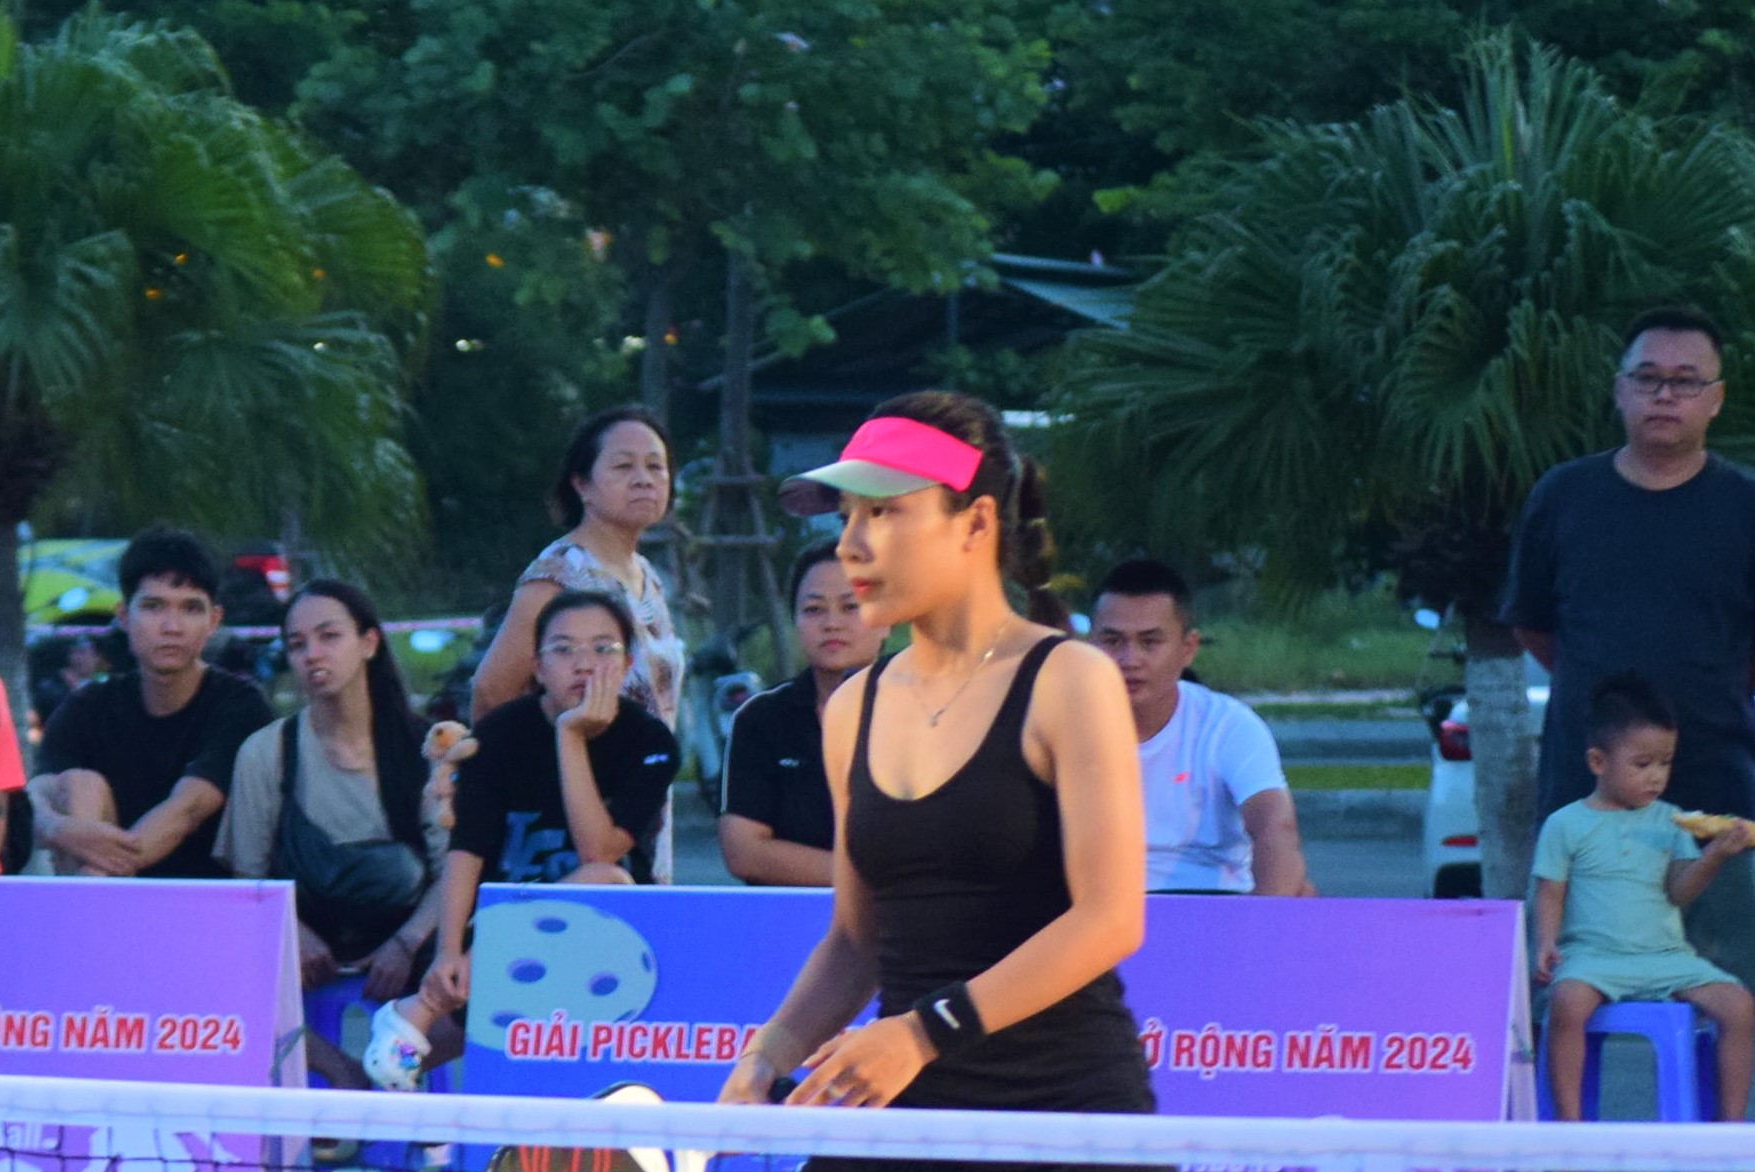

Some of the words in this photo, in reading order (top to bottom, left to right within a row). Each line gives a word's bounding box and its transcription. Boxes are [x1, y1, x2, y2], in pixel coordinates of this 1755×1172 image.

[63, 1004, 145, 1050] NĂM
[155, 1016, 243, 1052] 2024
[508, 1010, 579, 1058] GIẢI
[1173, 1024, 1273, 1080] RỘNG
[1284, 1023, 1372, 1071] NĂM
[1382, 1034, 1474, 1071] 2024
